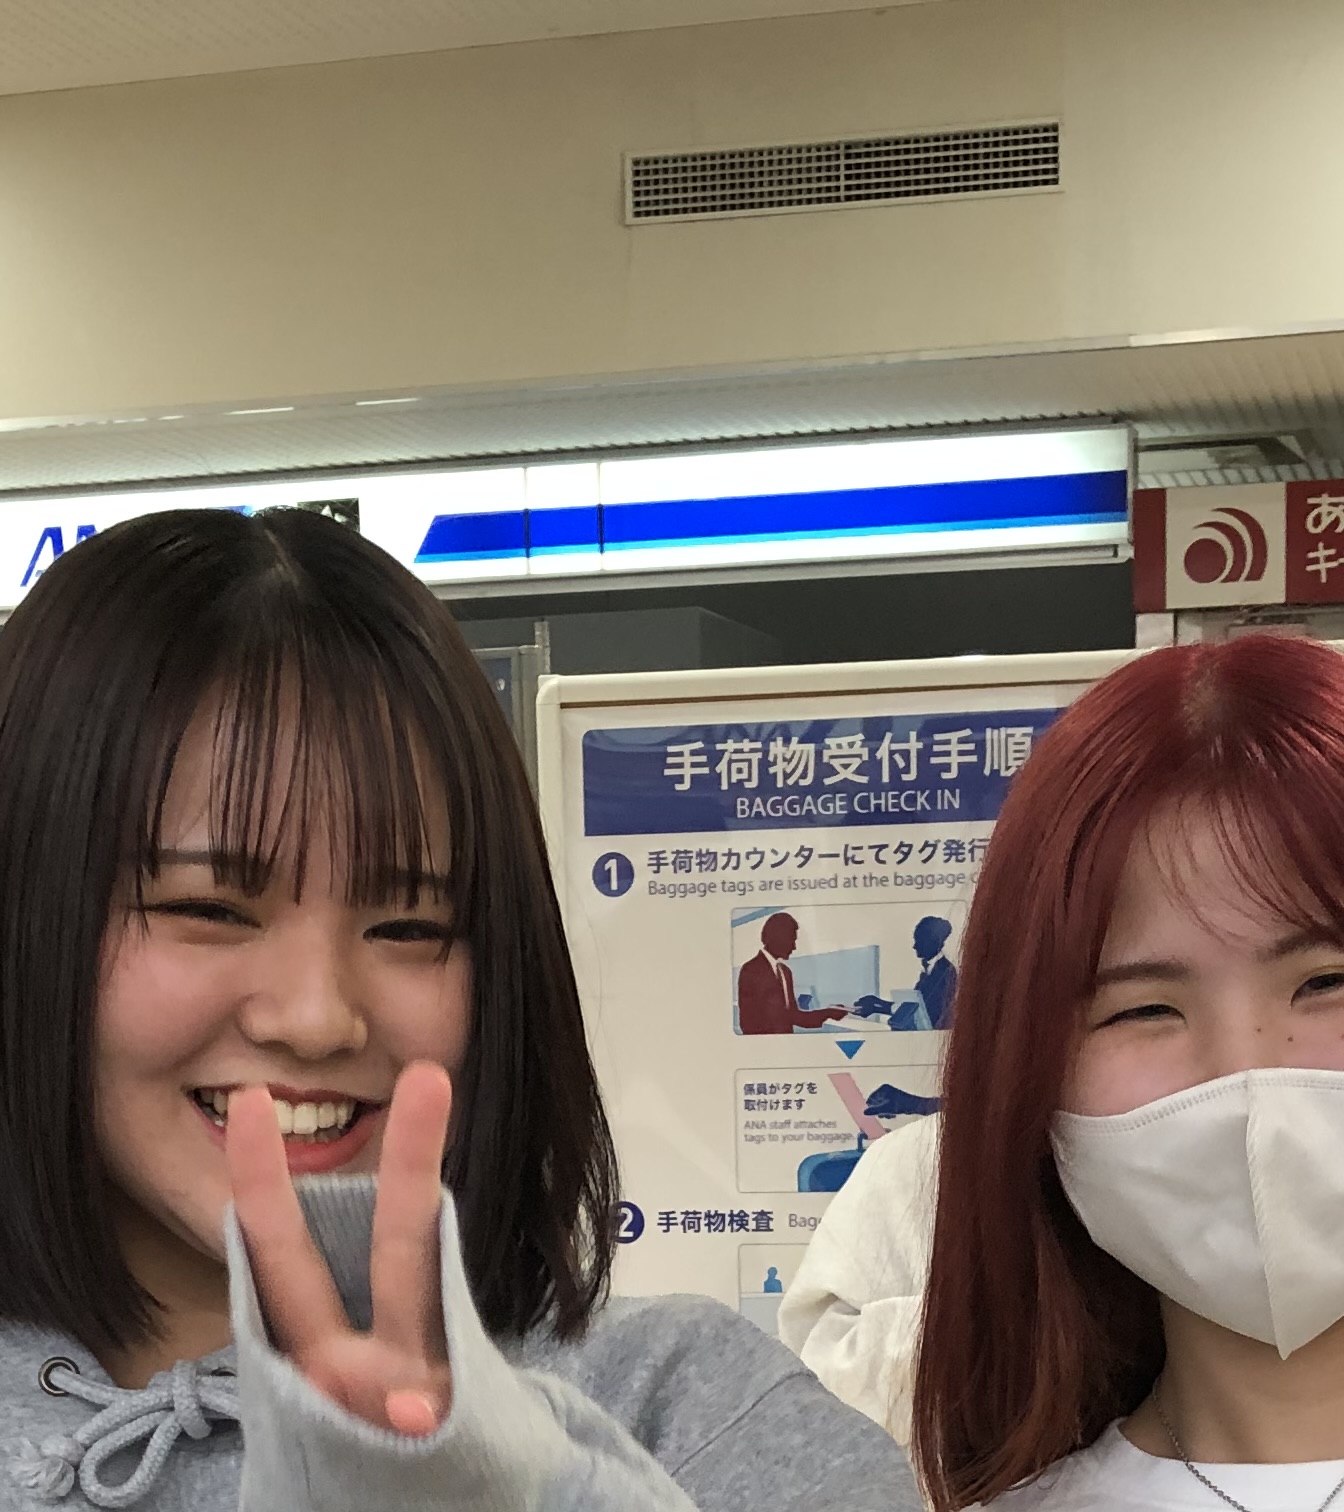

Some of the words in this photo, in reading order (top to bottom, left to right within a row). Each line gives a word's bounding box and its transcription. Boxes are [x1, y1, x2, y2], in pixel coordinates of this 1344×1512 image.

[663, 726, 1034, 792] 手荷物受付手順
[736, 792, 848, 818] BAGGAGE
[853, 790, 932, 813] CHECK
[937, 788, 961, 810] IN
[647, 838, 991, 875] 手荷物カウンターにてタグ発行
[647, 880, 717, 898] Baggage
[721, 879, 754, 896] tags
[758, 878, 784, 892] are
[787, 873, 838, 891] issued
[842, 874, 862, 889] at
[863, 871, 890, 888] the
[893, 870, 966, 889] baggage
[744, 1120, 766, 1130] ANA
[793, 1119, 837, 1129] attaches
[744, 1133, 765, 1145] tags
[768, 1132, 779, 1143] to
[782, 1133, 805, 1144] your
[657, 1209, 775, 1234] 手荷物検査
[788, 1213, 823, 1231] Bag
